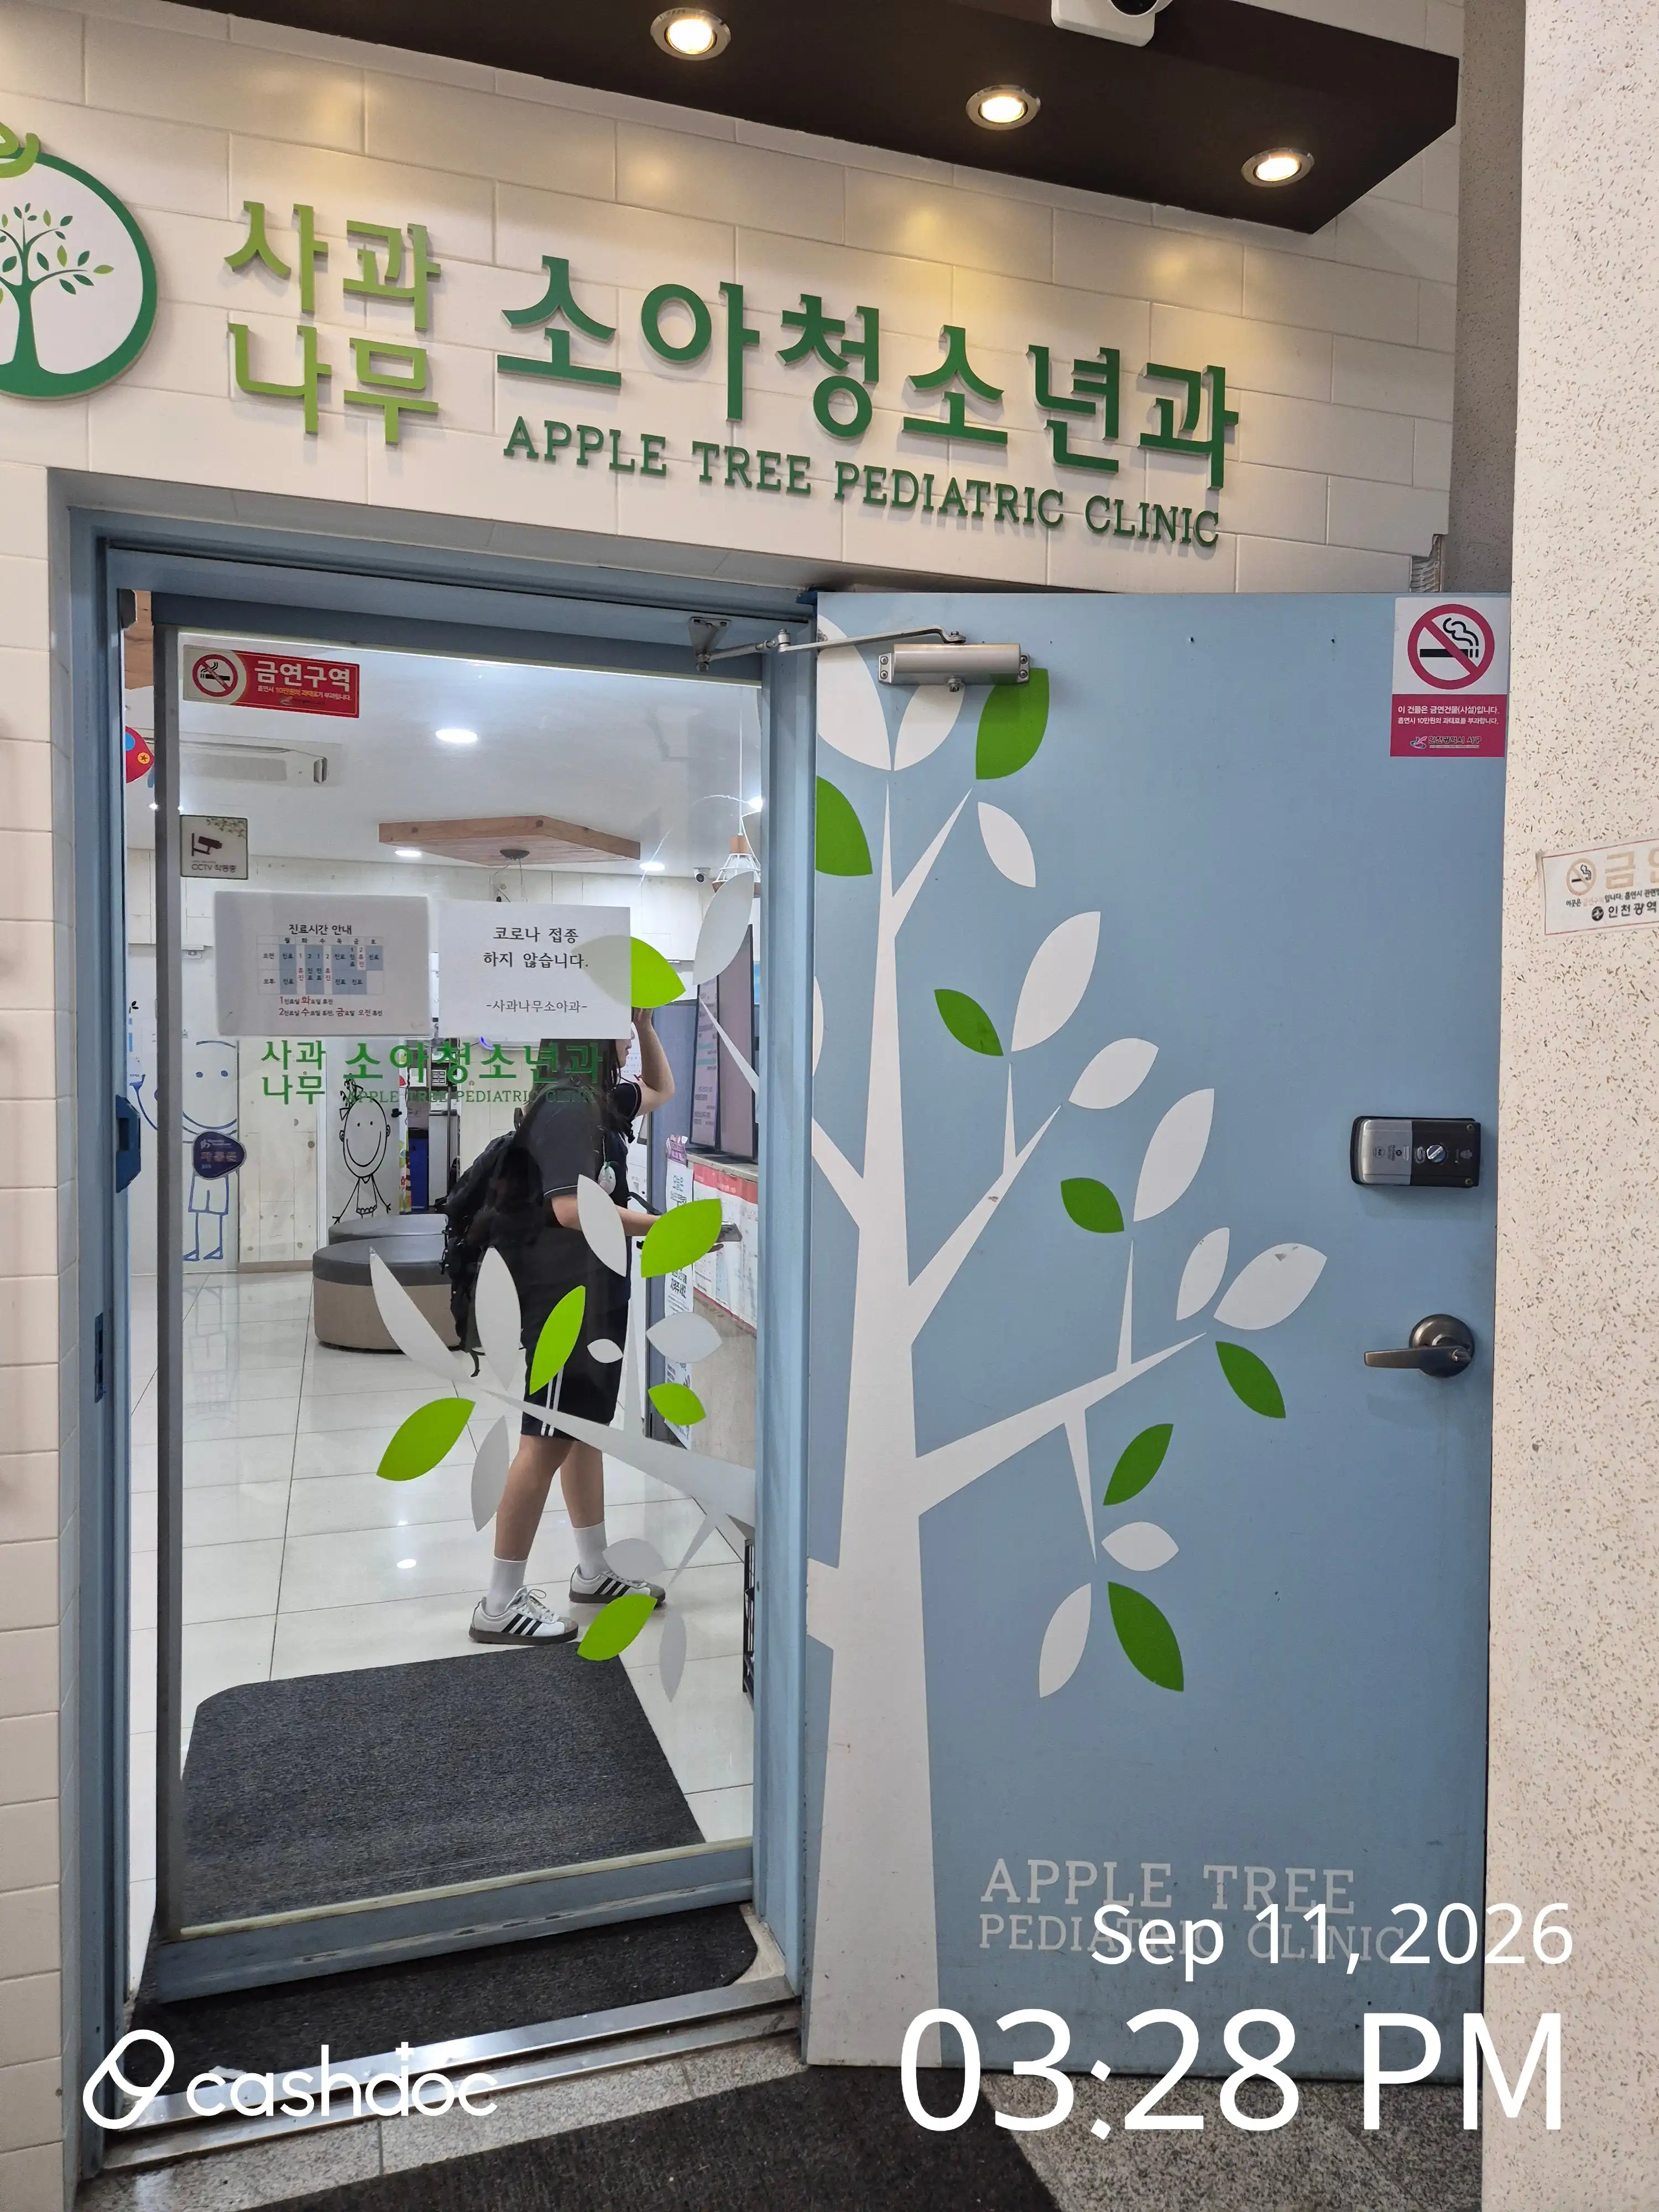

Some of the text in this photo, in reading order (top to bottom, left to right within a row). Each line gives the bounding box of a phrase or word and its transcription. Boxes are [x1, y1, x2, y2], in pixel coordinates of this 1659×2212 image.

[224, 200, 441, 331] 사과
[228, 322, 439, 444] 나무
[496, 255, 1239, 491] 소아청소년과
[503, 416, 1220, 547] APPLE TREE PEDIATRIC CLINIC
[254, 660, 349, 692] 금연구역
[1398, 706, 1405, 714] 이
[1566, 898, 1582, 907] 이곳은
[1624, 890, 1642, 900] 흡연시
[289, 924, 352, 936] 진료시간 안내
[493, 926, 579, 943] 코로나 접종
[483, 951, 588, 969] 하지 않습니다.
[279, 996, 300, 1005] 1진료실
[301, 995, 321, 1005] 화요일
[279, 1008, 299, 1016] 2진료실
[301, 1007, 321, 1016] 수요일
[336, 1008, 355, 1016] 금요일
[486, 999, 587, 1013] -사과나무소아과-
[261, 1040, 326, 1071] 사과
[343, 1041, 604, 1084] 소아청소년과
[261, 1074, 325, 1104] 나무
[347, 1090, 399, 1103] APPLE
[980, 1858, 1354, 1914] APPLE TREE
[1248, 1921, 1404, 1963] CLINIC
